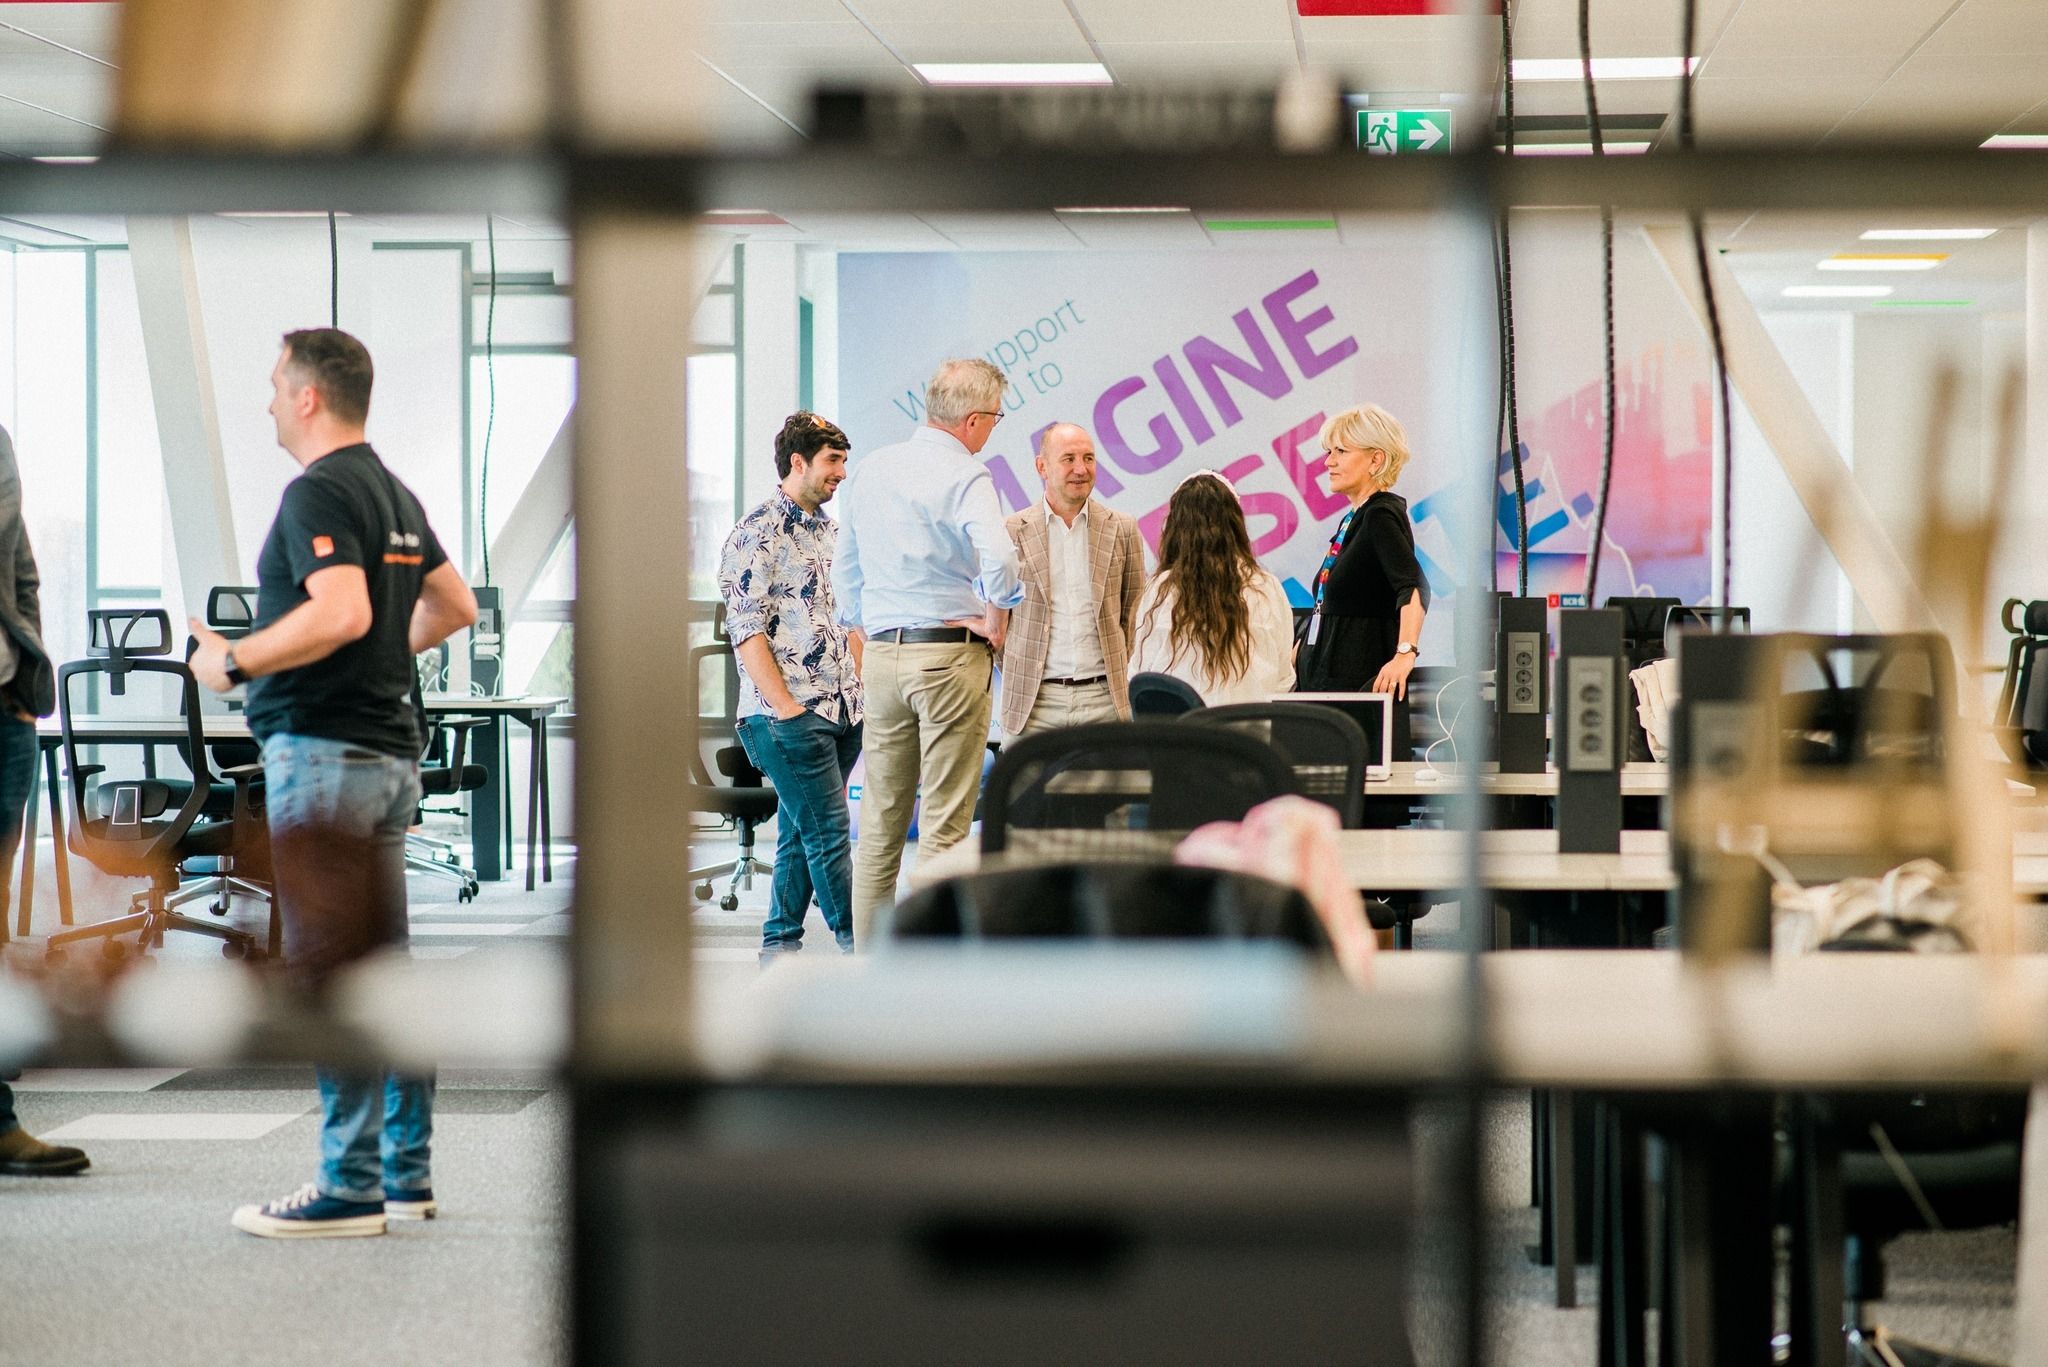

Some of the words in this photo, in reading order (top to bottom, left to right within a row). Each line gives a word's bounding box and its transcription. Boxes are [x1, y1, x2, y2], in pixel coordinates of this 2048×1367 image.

[986, 299, 1086, 374] pport
[984, 269, 1359, 512] GINE
[1027, 362, 1062, 394] to
